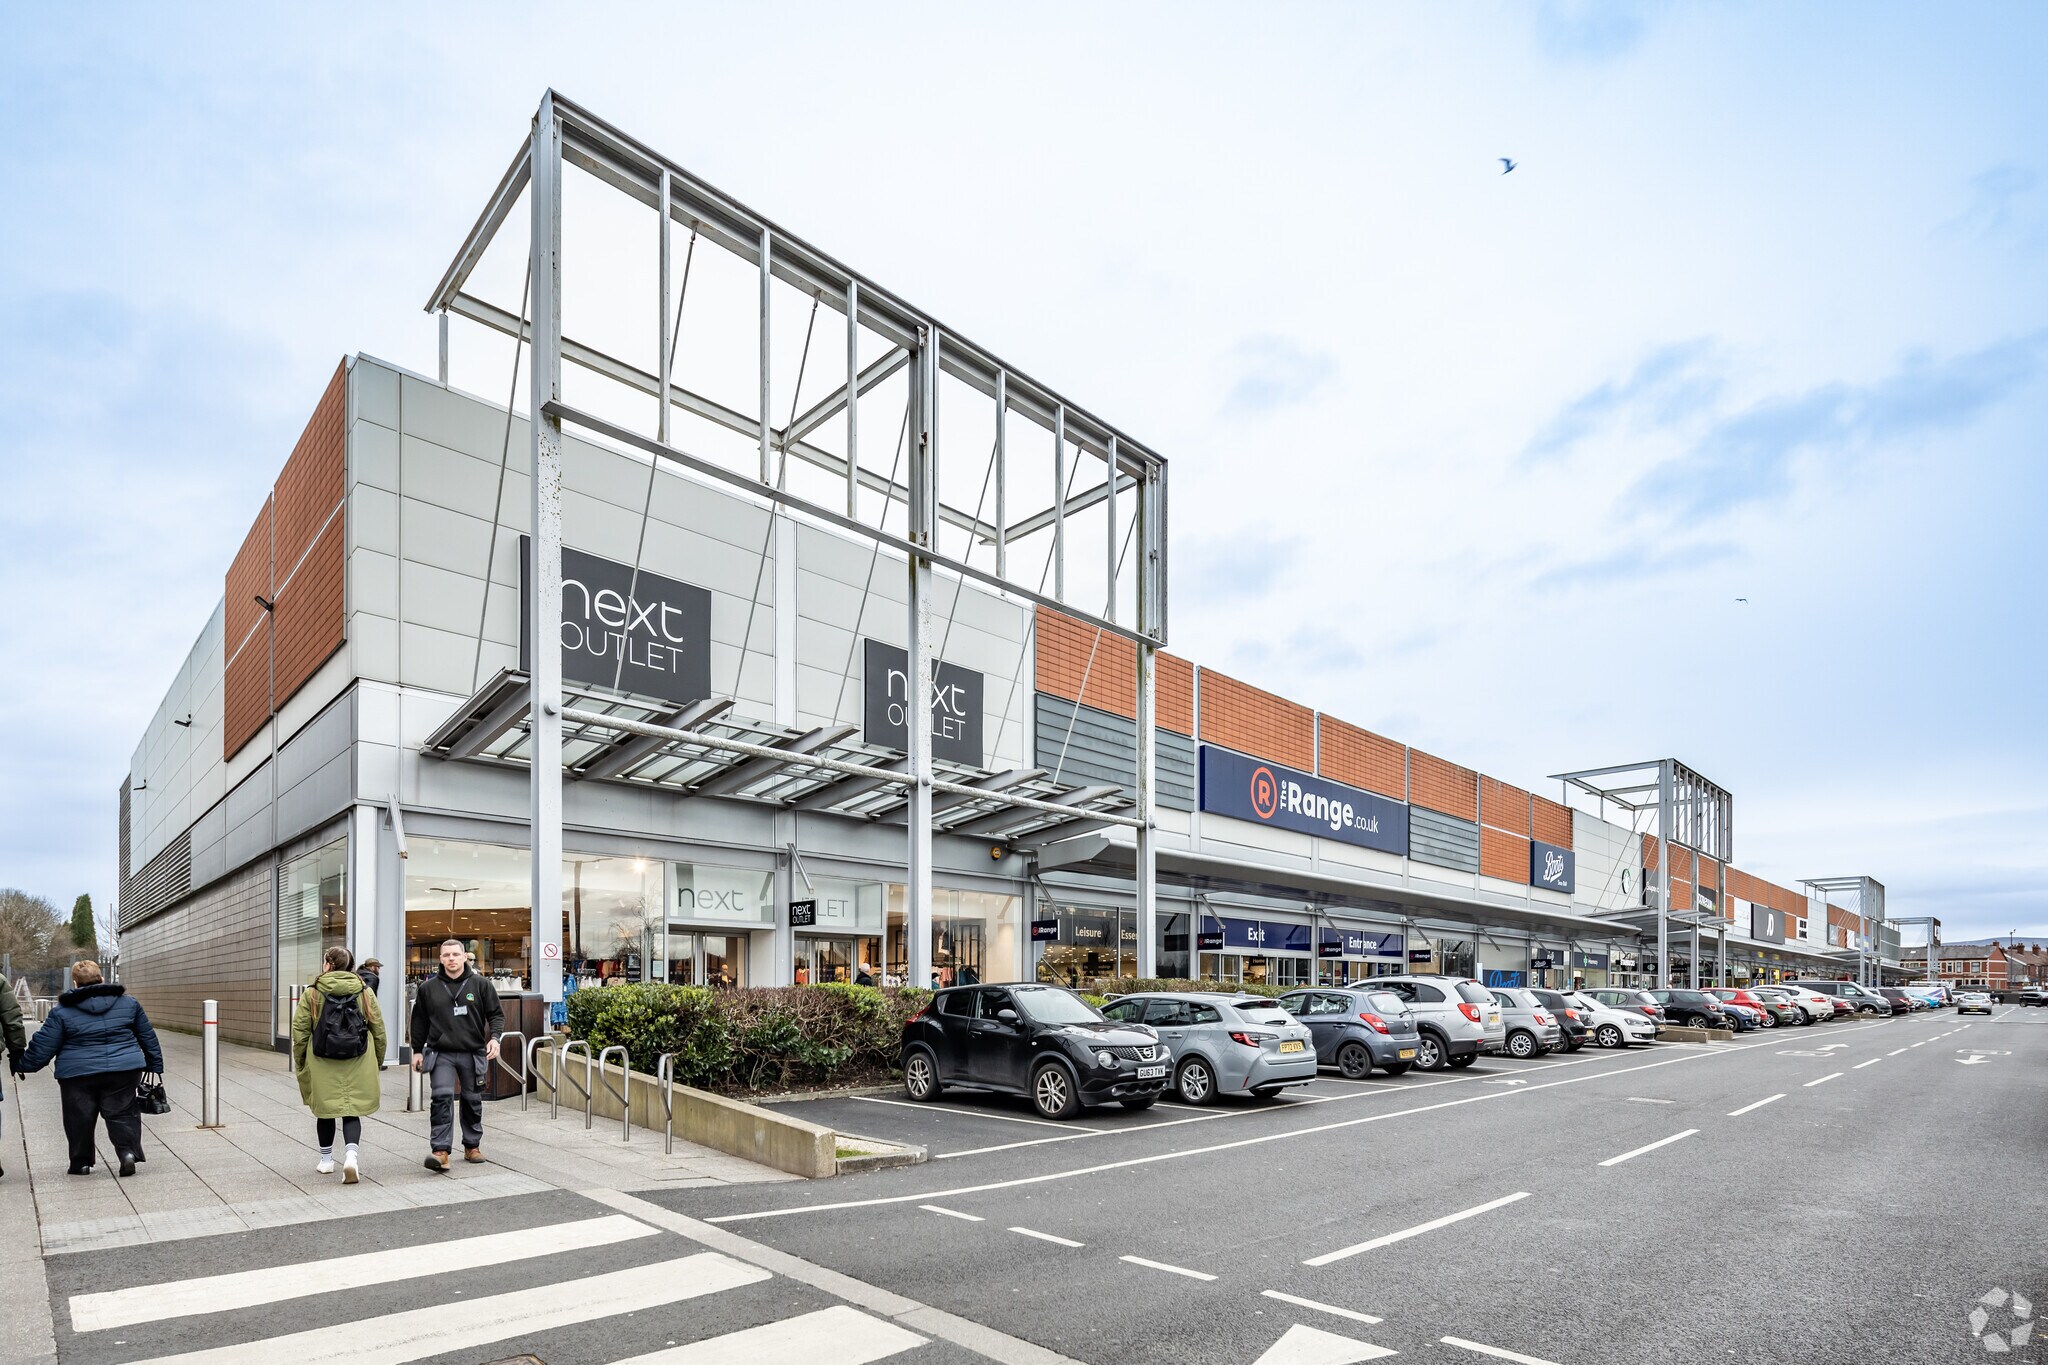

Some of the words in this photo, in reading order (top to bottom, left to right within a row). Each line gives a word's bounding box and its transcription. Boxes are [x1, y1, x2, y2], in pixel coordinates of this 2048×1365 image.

[561, 579, 684, 643] next
[561, 621, 684, 674] OUTLET
[887, 668, 966, 717] nxt
[887, 703, 966, 741] OLET
[1280, 779, 1288, 810] The
[678, 887, 744, 911] next
[792, 904, 811, 916] next
[792, 915, 811, 924] OUTLET
[1075, 926, 1102, 938] Leisure
[1247, 927, 1265, 941] Exit
[1348, 936, 1377, 950] Entrance
[1139, 1068, 1154, 1077] GU63
